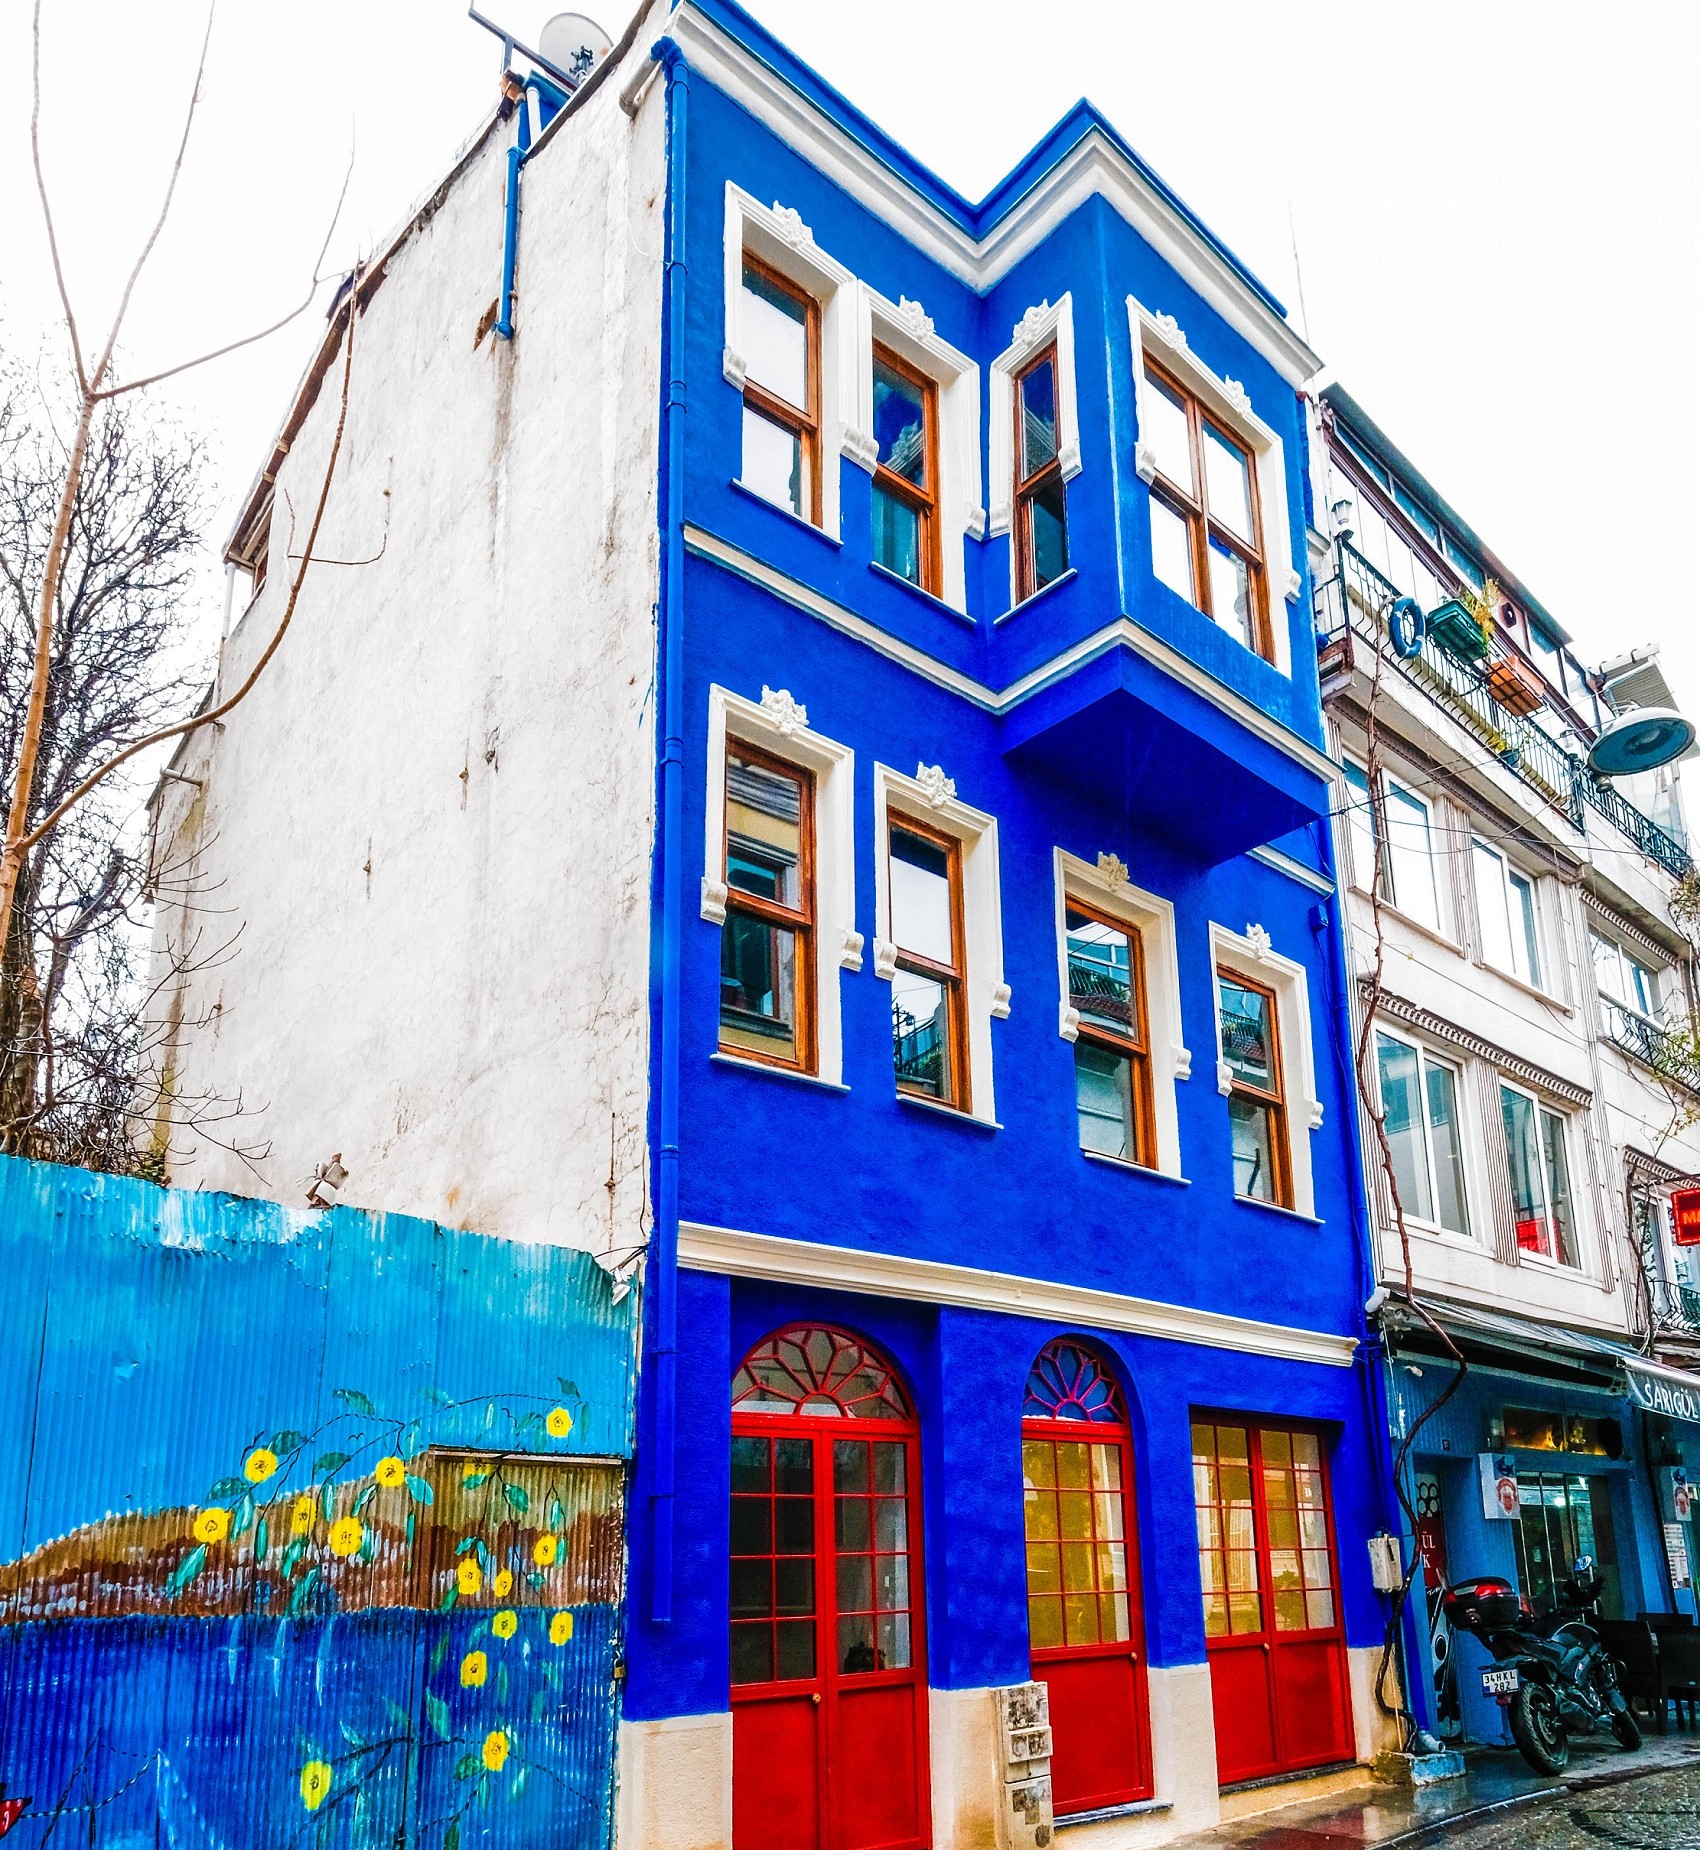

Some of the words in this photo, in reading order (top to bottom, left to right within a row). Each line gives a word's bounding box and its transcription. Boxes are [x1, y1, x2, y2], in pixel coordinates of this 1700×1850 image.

[1644, 1383, 1699, 1419] SARIGÜL
[1421, 1531, 1436, 1549] ÜL
[1494, 1681, 1511, 1692] 282
